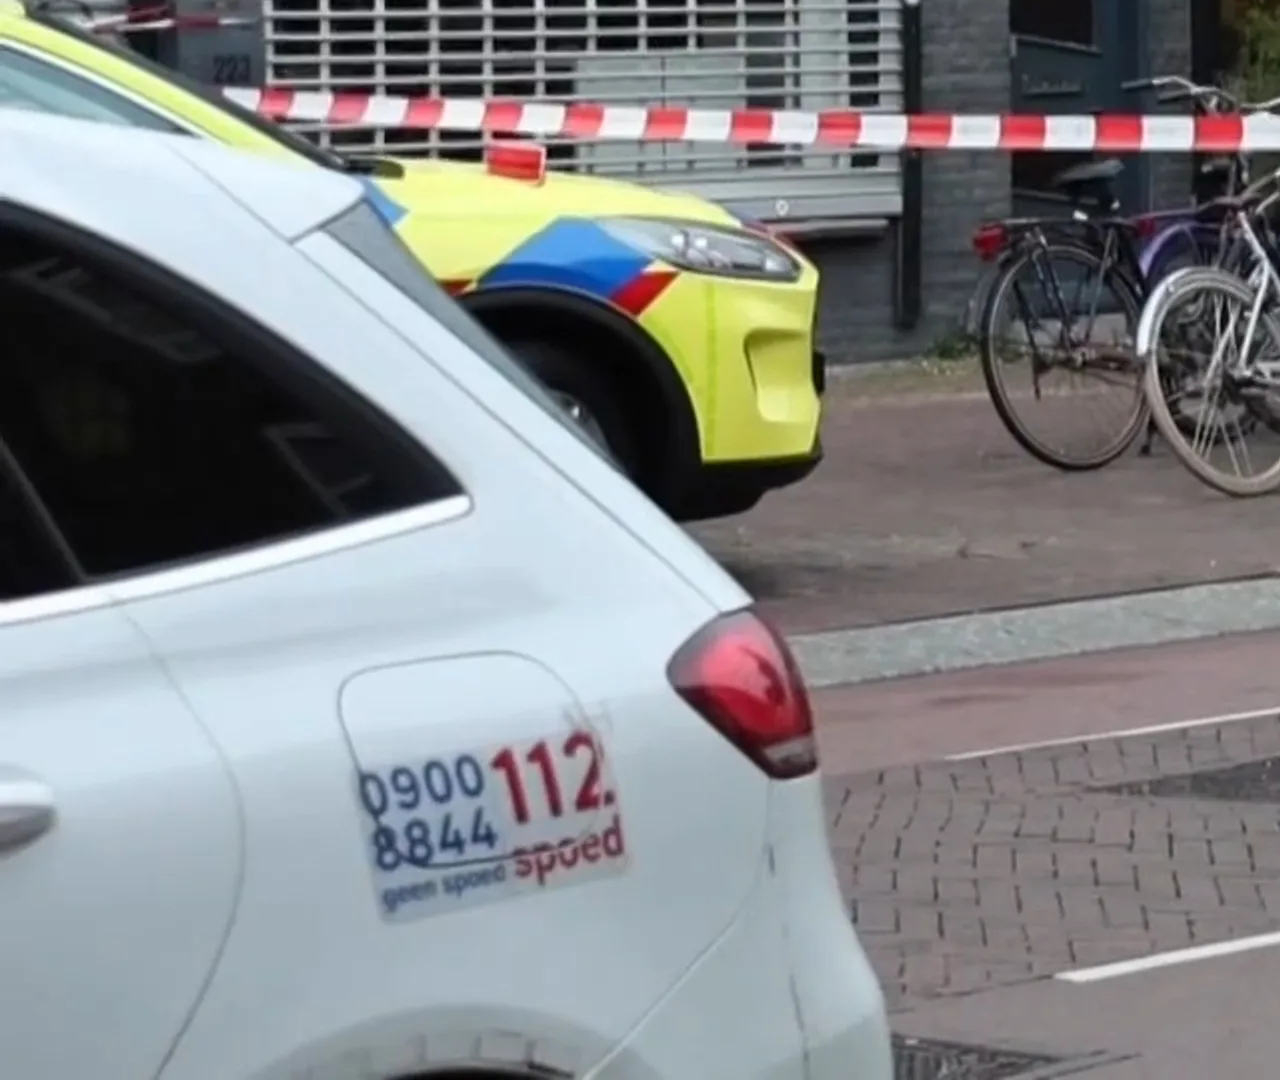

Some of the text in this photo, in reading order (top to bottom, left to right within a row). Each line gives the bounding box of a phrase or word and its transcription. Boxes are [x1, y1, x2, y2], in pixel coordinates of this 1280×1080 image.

[359, 754, 485, 818] 0900
[372, 806, 499, 871] 8844
[513, 813, 625, 886] spoed
[381, 879, 438, 913] geen
